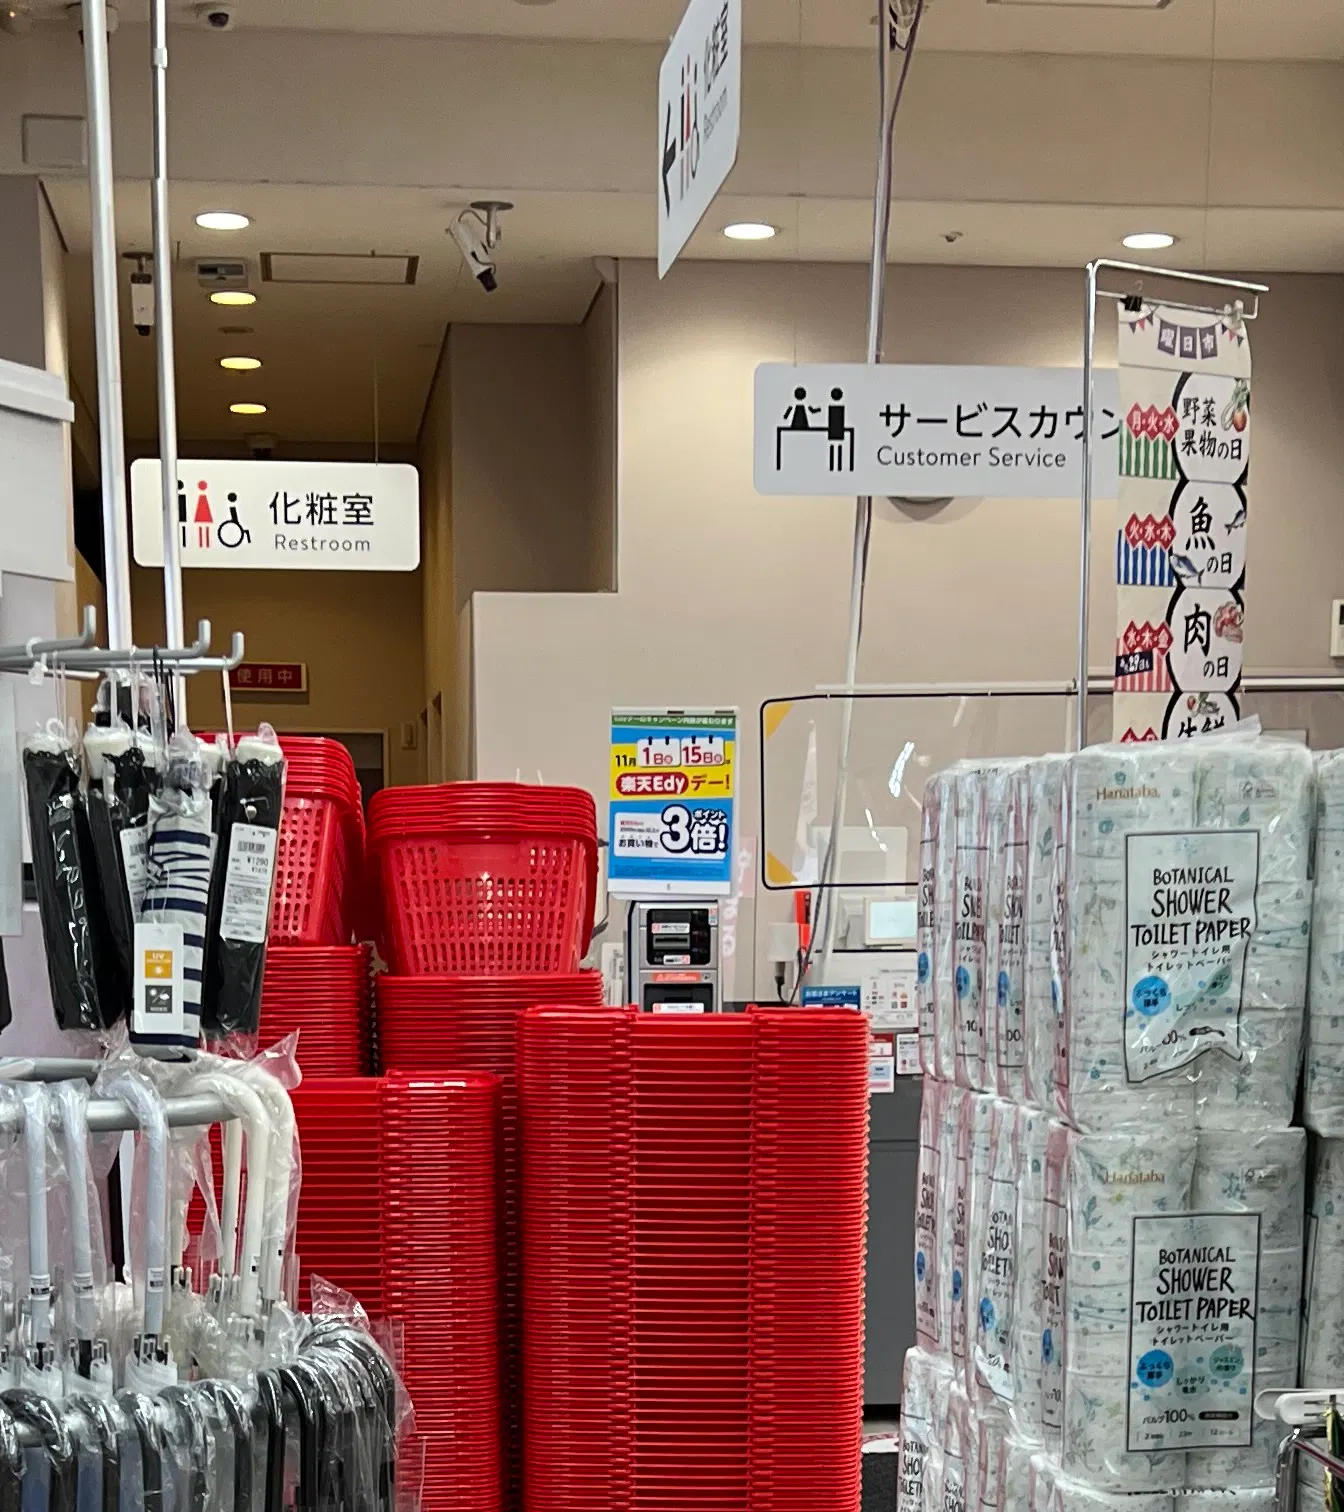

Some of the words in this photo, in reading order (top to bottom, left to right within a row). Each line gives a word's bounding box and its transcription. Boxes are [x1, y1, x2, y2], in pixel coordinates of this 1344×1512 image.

[1182, 397, 1218, 427] 野菜
[877, 445, 981, 468] Customer
[988, 446, 1066, 468] Service
[1181, 429, 1243, 461] 果物の日
[269, 491, 374, 527] 化粧室
[1185, 497, 1216, 550] 魚
[274, 534, 371, 552] Restroom
[1183, 604, 1211, 657] 肉
[237, 668, 293, 685] 使用中
[615, 754, 637, 767] 11月
[693, 810, 726, 820] ポイント
[661, 804, 691, 853] 3
[1154, 866, 1234, 886] BOTANICAL
[1151, 887, 1233, 919] SHOWER
[1196, 917, 1251, 944] PAPER
[1151, 944, 1232, 960] シャワートイレ用
[1147, 957, 1232, 972] トイレットペーパー
[1159, 1247, 1235, 1265] BOTANICAL
[1157, 1267, 1234, 1294] SHOWER
[1197, 1297, 1255, 1321] PAPER
[1157, 1324, 1229, 1334] シャワートイレ用
